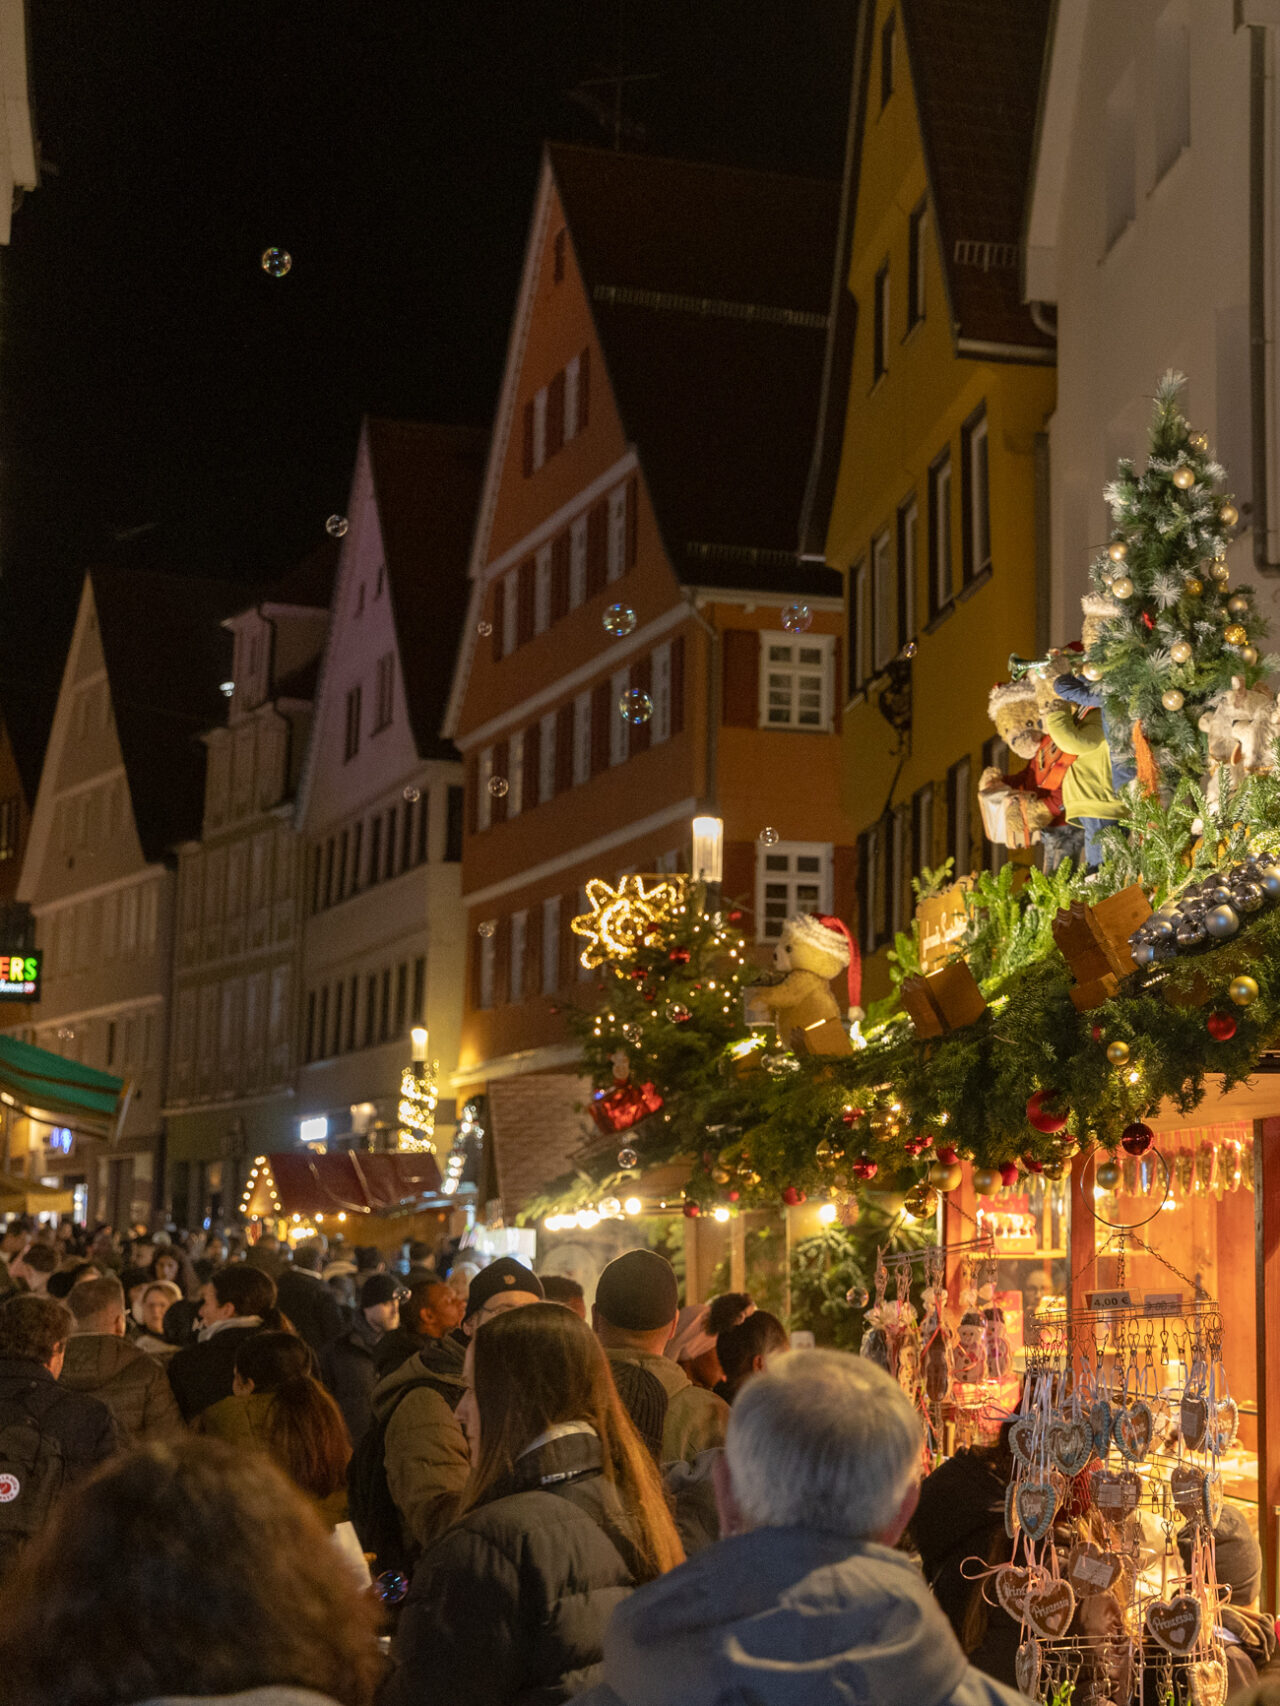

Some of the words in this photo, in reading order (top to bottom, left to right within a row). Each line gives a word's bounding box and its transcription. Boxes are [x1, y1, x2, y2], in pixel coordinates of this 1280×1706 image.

[1093, 1297, 1118, 1308] 4,00
[1121, 1296, 1129, 1306] €
[1032, 1598, 1069, 1618] Prinzessin
[1152, 1611, 1194, 1632] Prinzessin
